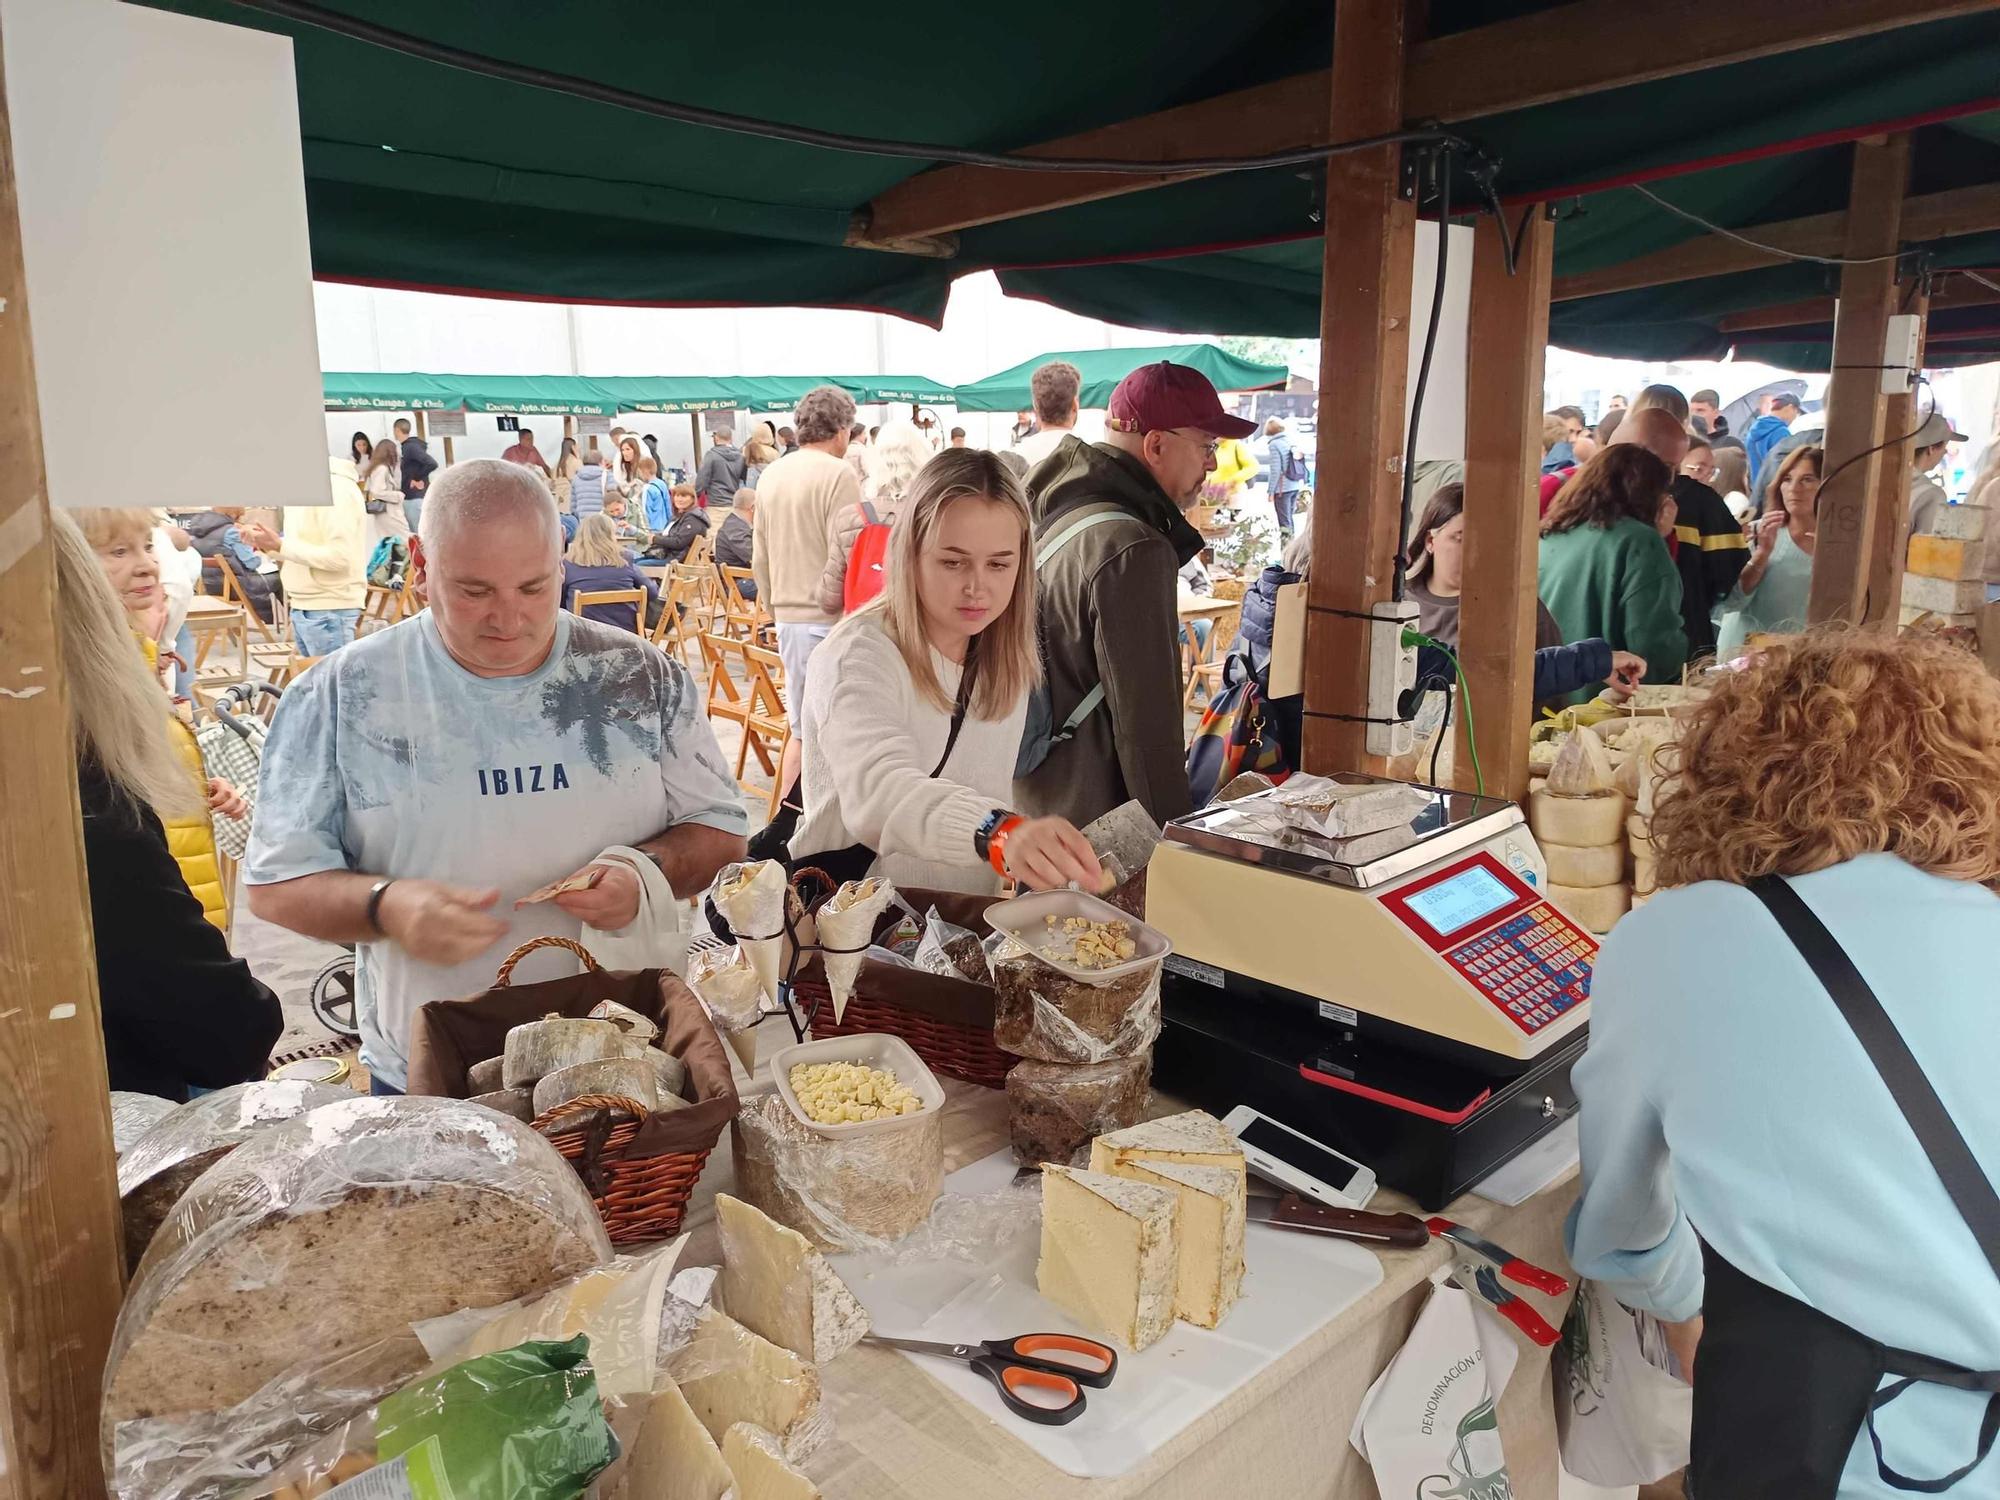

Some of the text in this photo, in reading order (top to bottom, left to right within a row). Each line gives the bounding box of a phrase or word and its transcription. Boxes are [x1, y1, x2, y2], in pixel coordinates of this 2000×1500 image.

[373, 399, 406, 409] Cangas
[411, 399, 423, 408] de
[541, 405, 570, 414] Cangas
[573, 405, 583, 413] de
[478, 763, 570, 796] IBIZA
[1421, 1357, 1475, 1436] DENOMINACIÓN
